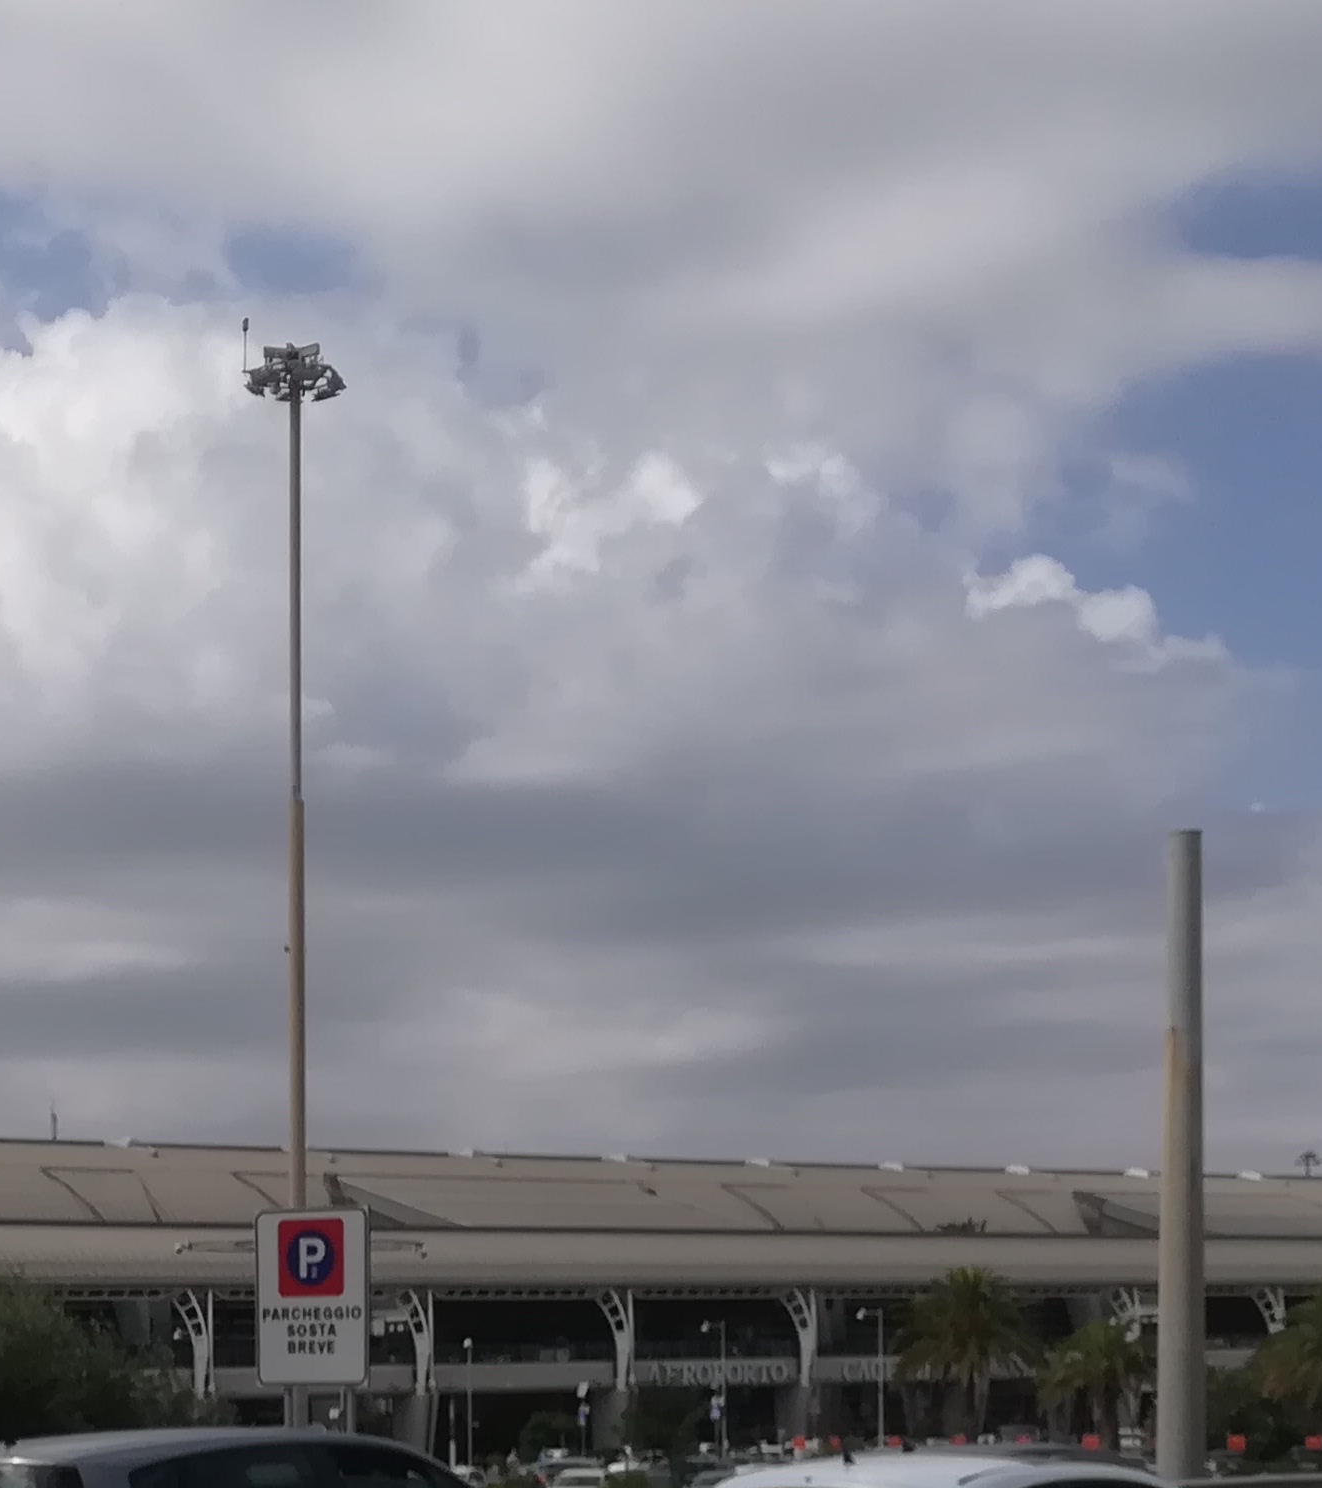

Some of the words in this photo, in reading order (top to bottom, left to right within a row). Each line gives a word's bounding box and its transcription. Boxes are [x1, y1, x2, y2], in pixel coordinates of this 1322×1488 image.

[262, 1304, 362, 1322] PARCHEGGIO
[287, 1322, 337, 1337] SOSTA
[287, 1339, 335, 1354] BREVE
